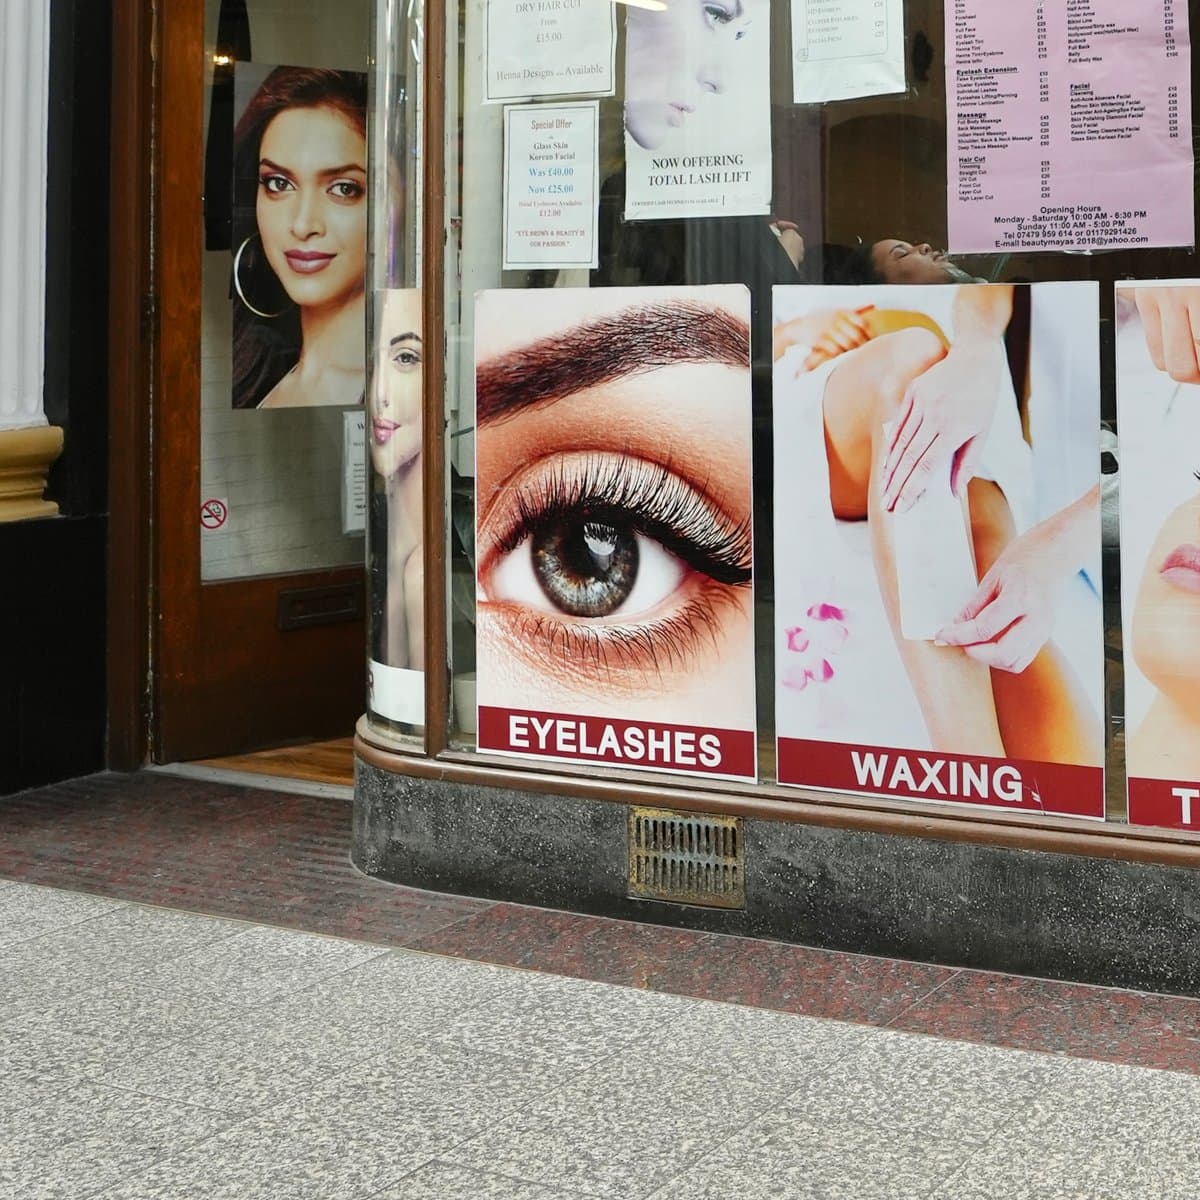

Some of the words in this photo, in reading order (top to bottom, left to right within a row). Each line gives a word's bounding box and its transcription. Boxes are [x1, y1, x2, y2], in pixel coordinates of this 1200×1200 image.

[516, 4, 535, 14] DRY
[538, 0, 560, 12] HAIR
[563, 0, 582, 9] CUT
[497, 70, 520, 80] Henna
[524, 69, 554, 80] Designs
[565, 64, 604, 76] Available
[531, 120, 554, 131] Special
[556, 120, 572, 128] Offer
[652, 158, 680, 170] NOW
[682, 154, 743, 168] OFFERING
[528, 168, 545, 177] Was
[548, 168, 574, 177] £40.00
[648, 174, 687, 186] TOTAL
[690, 172, 721, 185] LASH
[724, 171, 751, 183] LIFT
[528, 185, 546, 194] Now
[548, 184, 574, 194] £25.00
[1022, 238, 1073, 247] beautymayas
[1076, 236, 1148, 245] 2018@yahoo.com
[508, 715, 722, 768] EYELASHES
[851, 750, 1024, 802] WAXING
